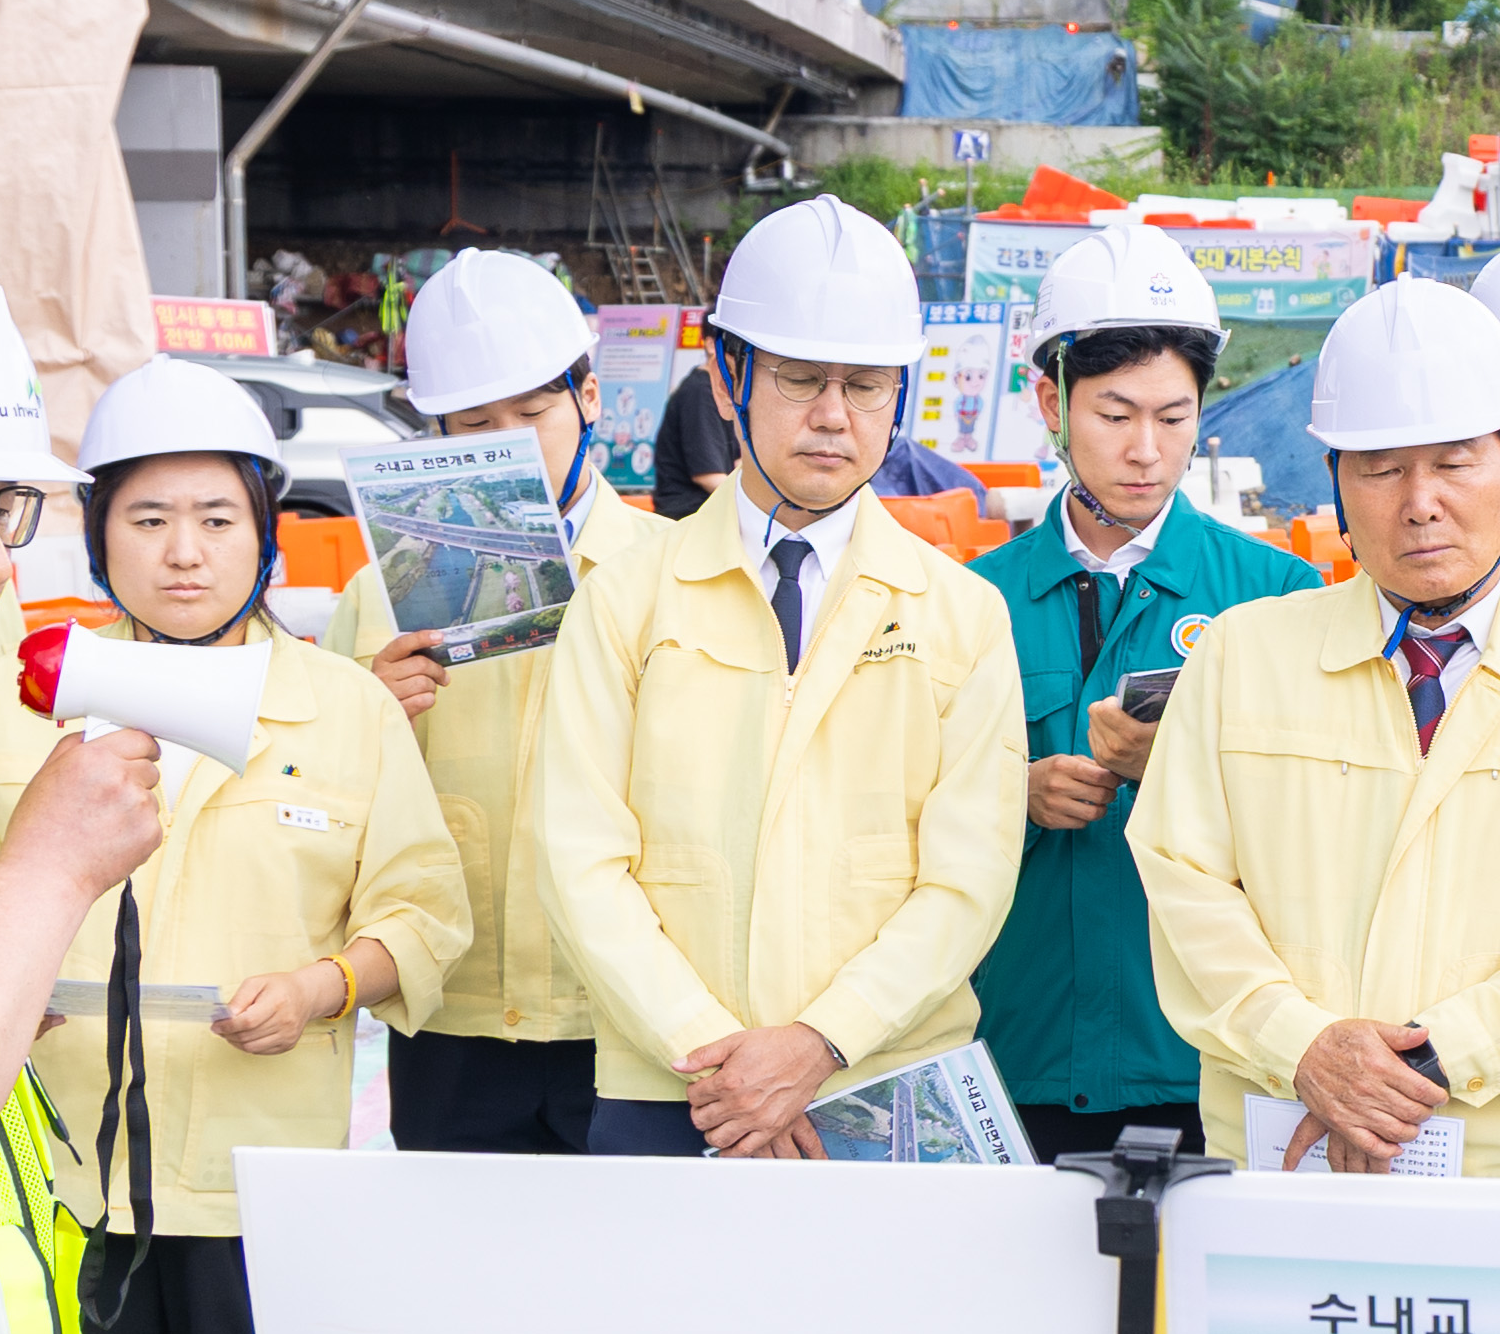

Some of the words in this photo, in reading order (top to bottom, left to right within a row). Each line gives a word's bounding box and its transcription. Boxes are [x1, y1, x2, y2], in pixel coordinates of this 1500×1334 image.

[1195, 247, 1225, 272] 5대
[1229, 245, 1301, 272] 기본수칙
[163, 328, 205, 350] 전방
[211, 331, 257, 351] 10M
[374, 459, 415, 474] 수내교
[421, 453, 477, 470] 전면개축
[483, 448, 512, 463] 공사
[960, 1074, 987, 1113] 수내교
